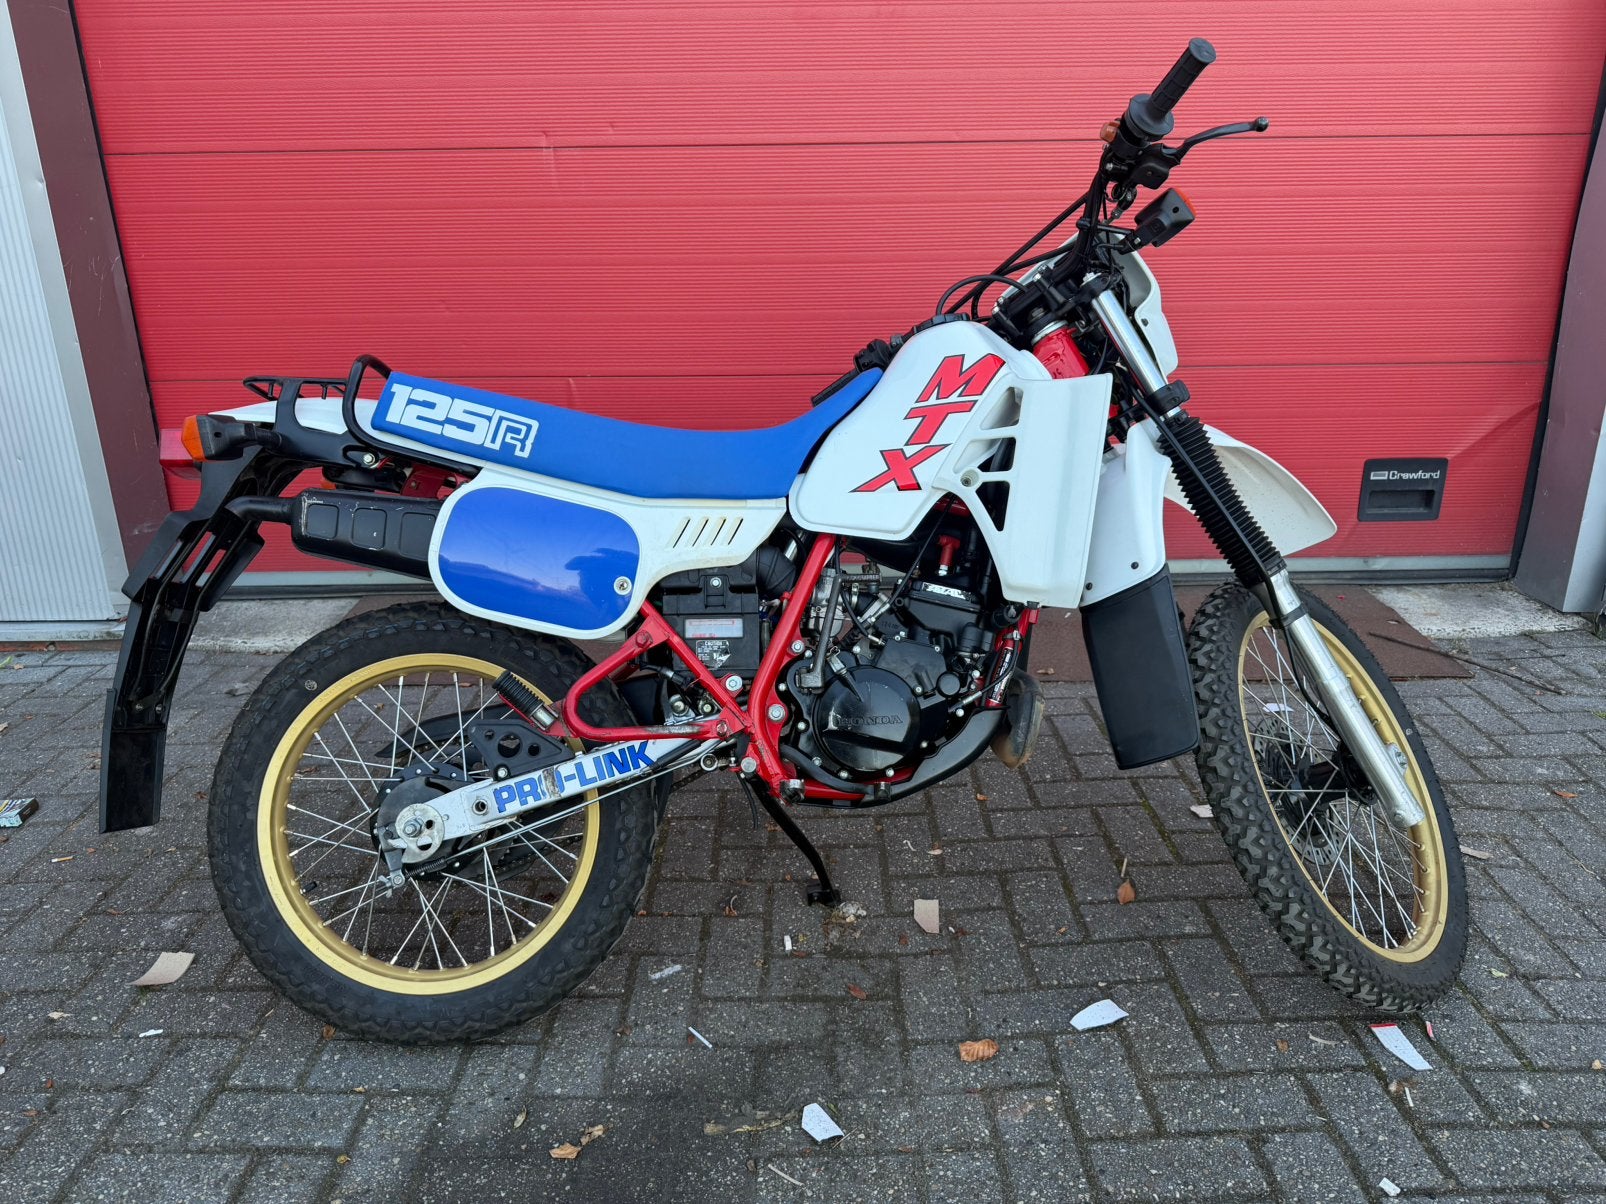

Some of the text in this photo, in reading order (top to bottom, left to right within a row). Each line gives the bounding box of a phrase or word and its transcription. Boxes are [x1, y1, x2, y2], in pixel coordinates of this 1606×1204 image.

[385, 383, 540, 458] 125R
[1389, 470, 1441, 480] Crawford
[838, 714, 903, 727] HONDA
